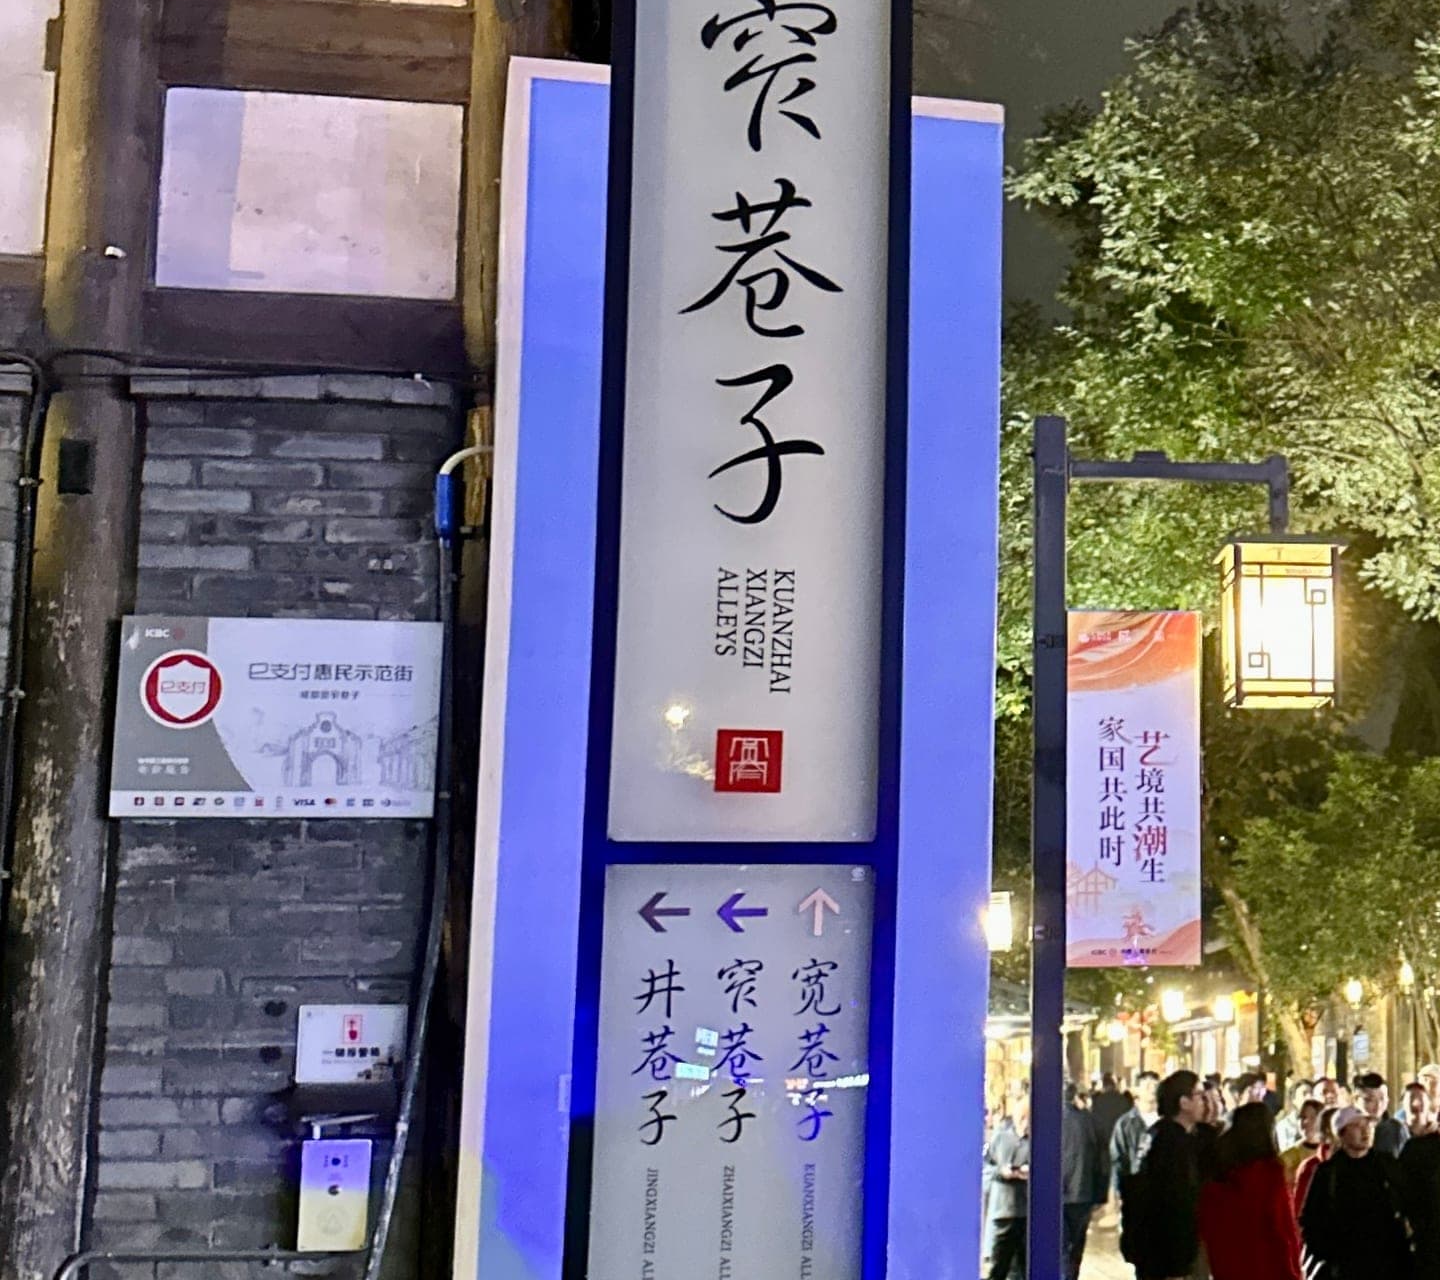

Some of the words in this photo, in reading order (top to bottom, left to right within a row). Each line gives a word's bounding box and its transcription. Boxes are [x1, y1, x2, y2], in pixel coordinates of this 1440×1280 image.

[715, 567, 739, 656] ALLEYS
[743, 568, 768, 668] XIANGZI
[769, 569, 795, 694] KUANZHAI
[1098, 716, 1134, 867] 家国共此时
[1132, 730, 1175, 884] 艺境共潮生
[631, 959, 686, 1146] 井巷子
[709, 959, 764, 1144] 窄巷子
[789, 959, 842, 1142] 宽巷子
[642, 1168, 659, 1254] JINGXIANGZI
[719, 1165, 735, 1252] ZHAIXIANGZI
[800, 1164, 817, 1251] KUANXIANGZI
